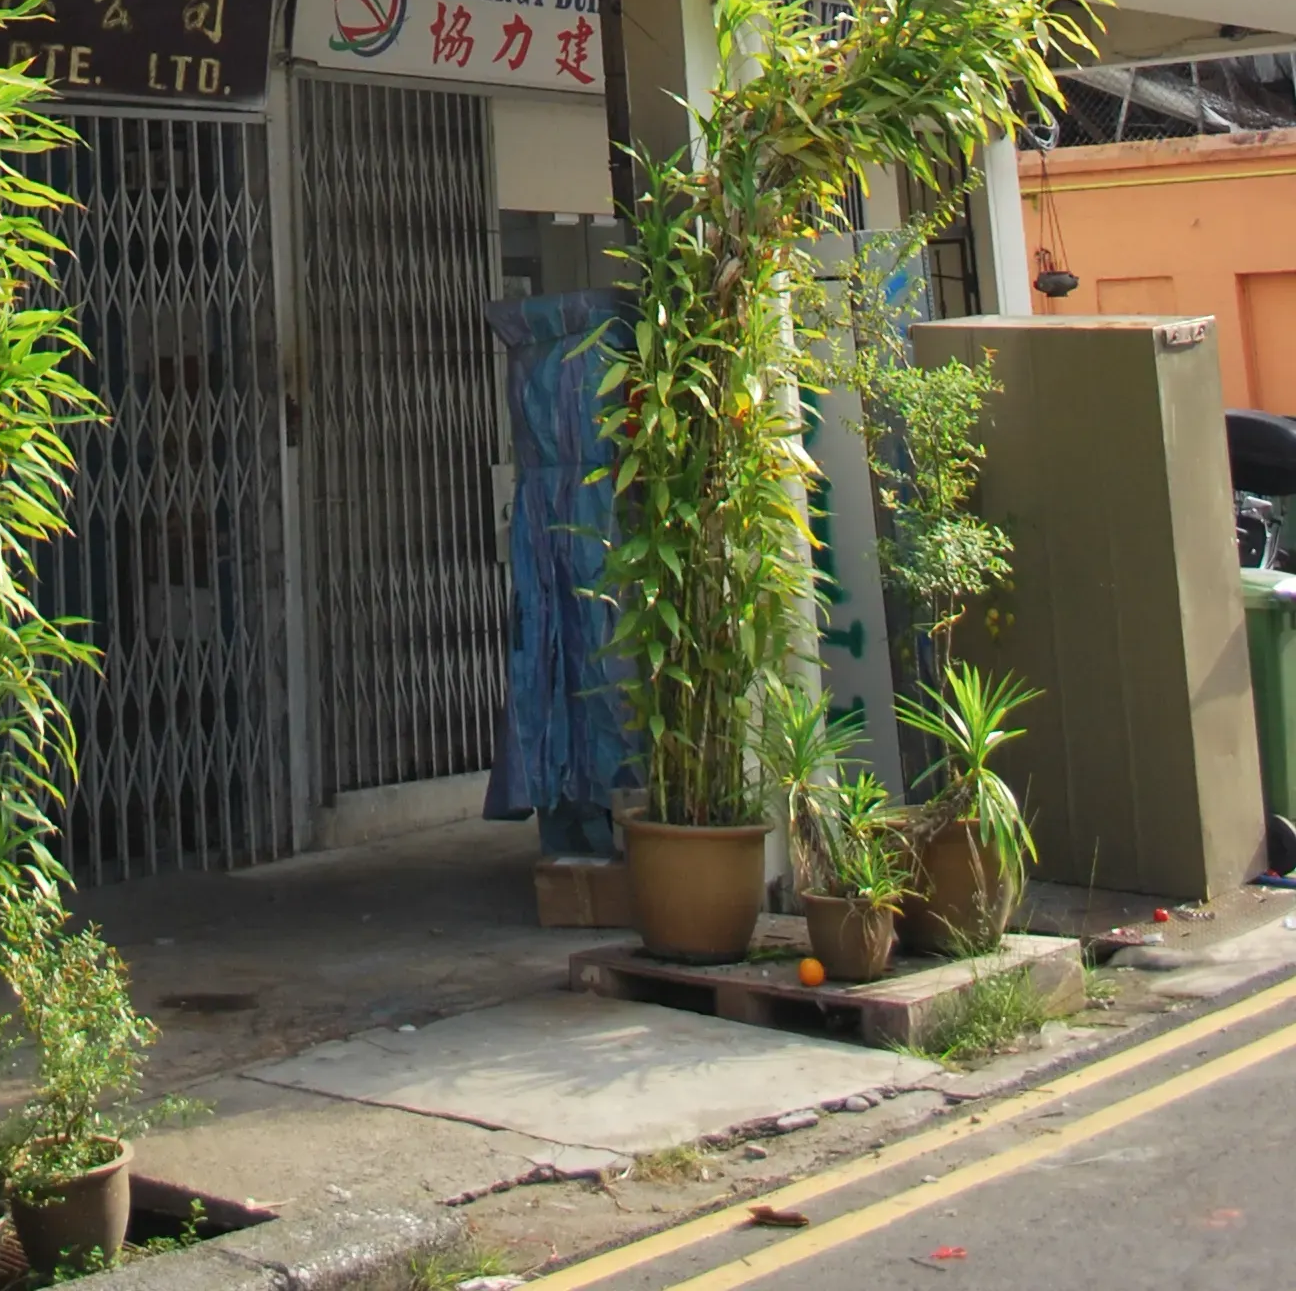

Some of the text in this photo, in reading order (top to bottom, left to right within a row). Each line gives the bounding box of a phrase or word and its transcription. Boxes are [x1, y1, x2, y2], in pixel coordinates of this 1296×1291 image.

[149, 52, 231, 95] LTD.
[430, 2, 595, 84] 協力建
